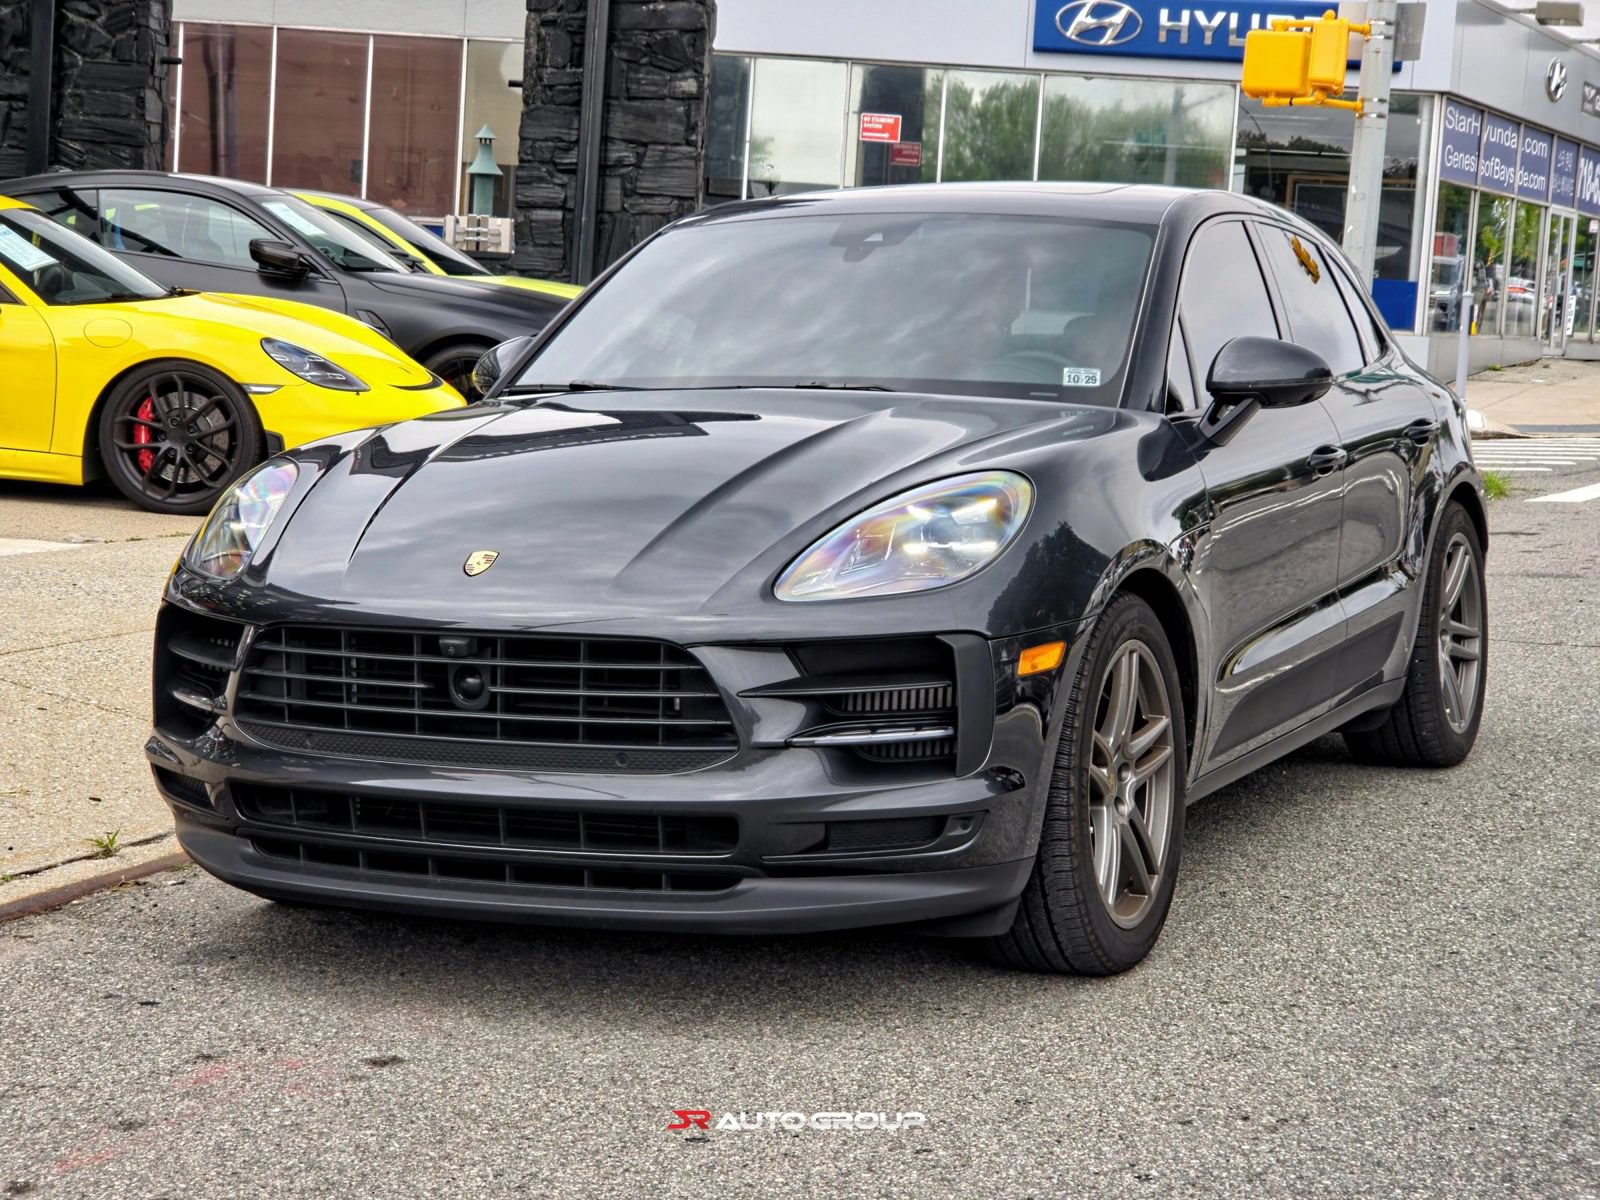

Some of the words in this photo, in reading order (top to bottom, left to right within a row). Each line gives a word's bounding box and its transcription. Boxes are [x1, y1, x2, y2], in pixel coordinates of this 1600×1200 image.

[1445, 106, 1548, 158] StarHyunda.com
[1444, 144, 1546, 191] GenesisofBaysde.com
[1067, 374, 1080, 383] 10
[1084, 375, 1097, 384] 29
